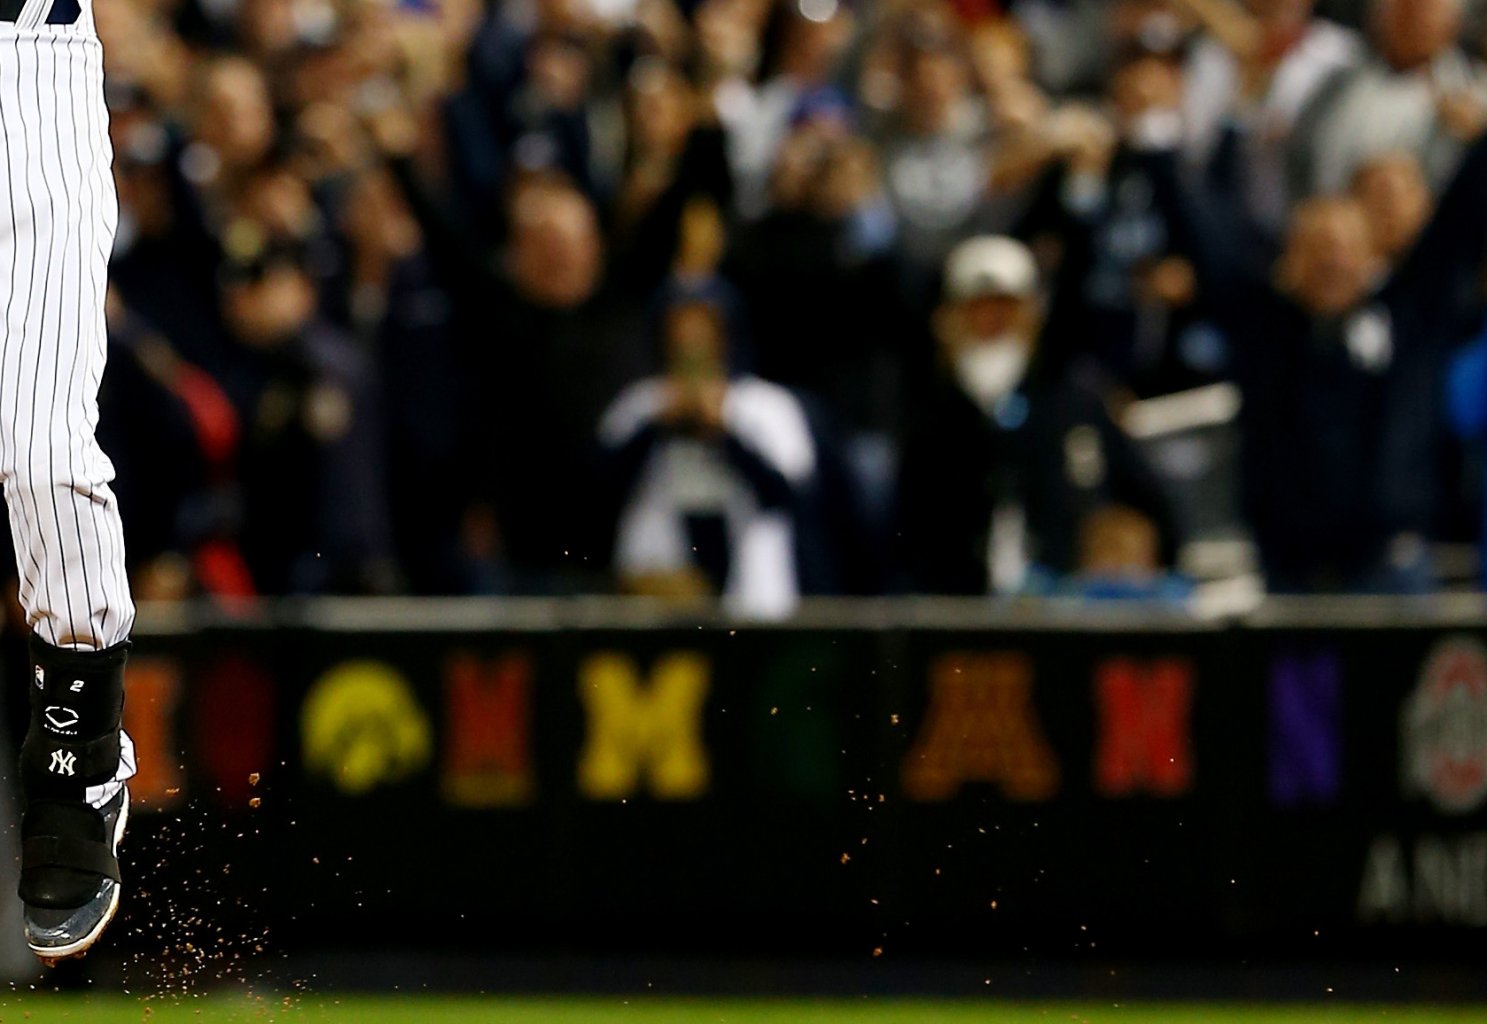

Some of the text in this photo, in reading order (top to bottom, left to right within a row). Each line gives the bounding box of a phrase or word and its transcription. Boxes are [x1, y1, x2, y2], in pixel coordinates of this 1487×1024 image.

[69, 679, 85, 693] 2
[578, 651, 710, 799] M
[48, 748, 77, 777] NY
